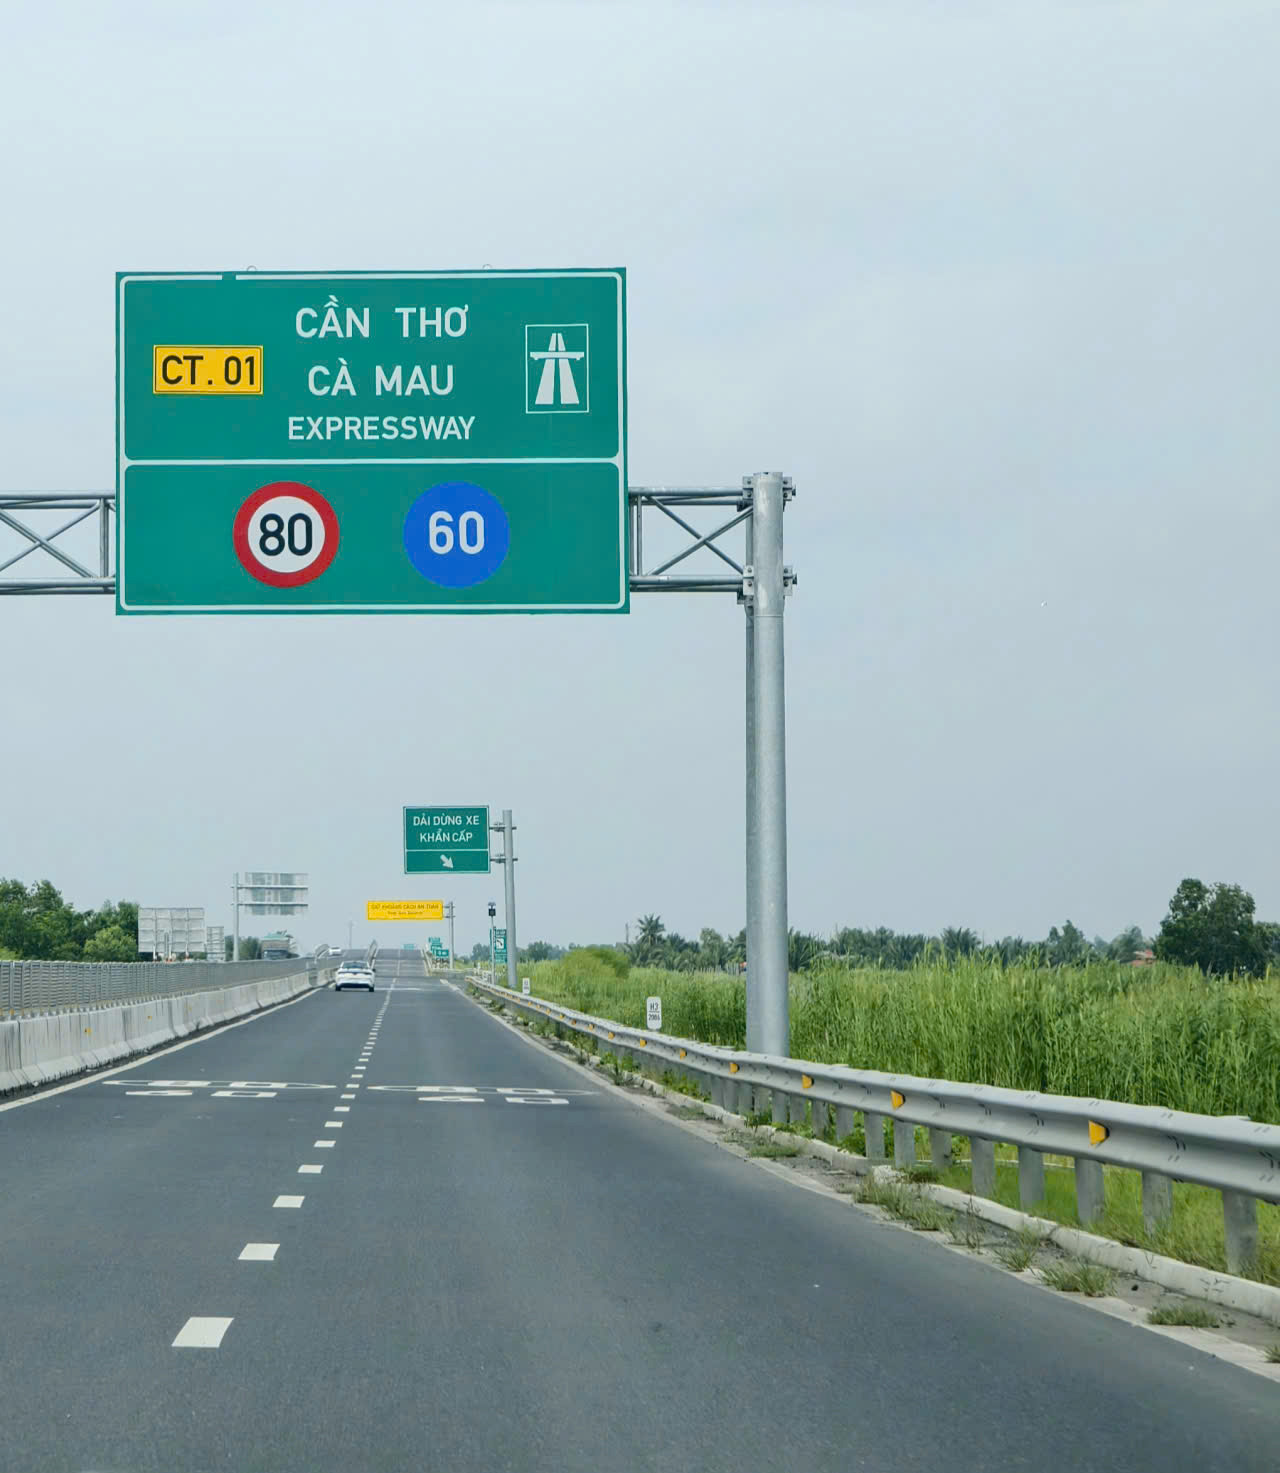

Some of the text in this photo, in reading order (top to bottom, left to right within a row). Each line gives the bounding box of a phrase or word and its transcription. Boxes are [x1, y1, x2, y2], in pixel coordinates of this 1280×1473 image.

[295, 294, 469, 338] CẦN THƠ
[162, 355, 255, 385] CT. 01
[308, 357, 454, 396] CÀ MAU
[288, 416, 475, 440] EXPRESSWAY
[258, 512, 313, 557] 80
[428, 510, 484, 555] 60
[452, 829, 473, 842] CẤP
[466, 815, 480, 825] XE
